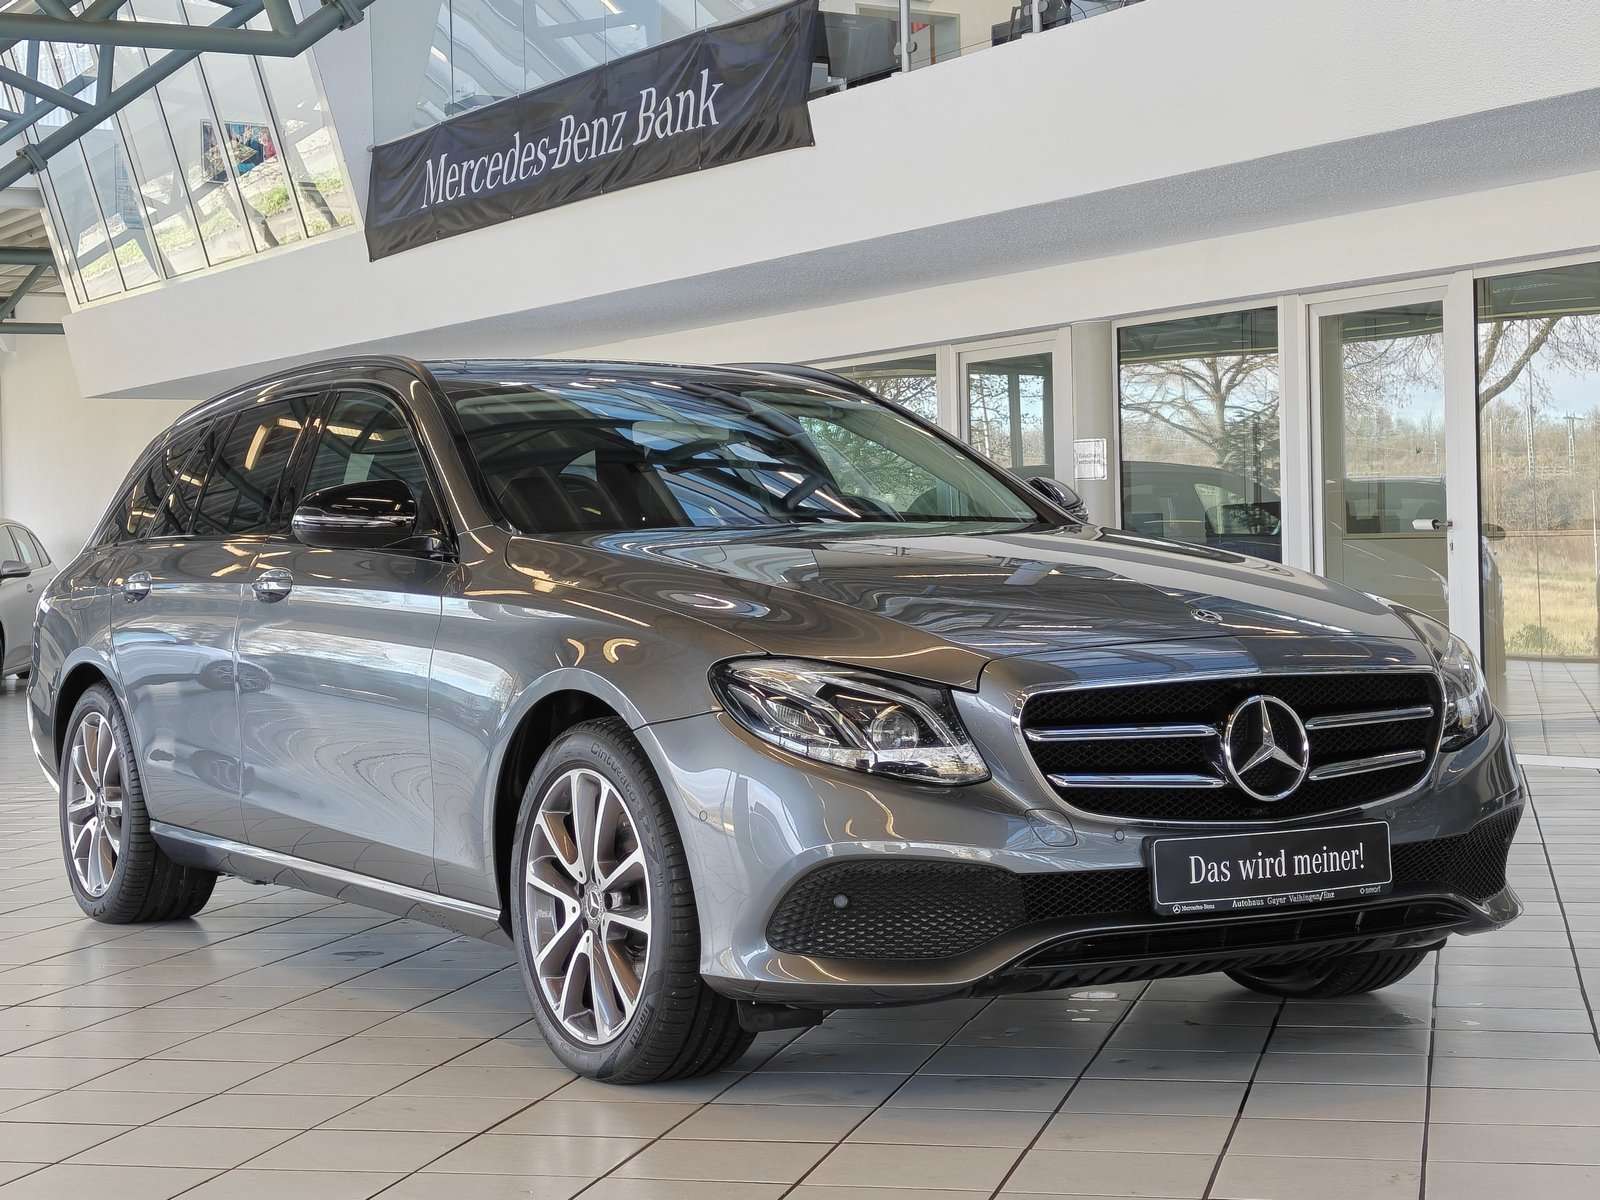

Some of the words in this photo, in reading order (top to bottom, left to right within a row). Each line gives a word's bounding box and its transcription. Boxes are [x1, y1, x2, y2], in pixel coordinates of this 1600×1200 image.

[421, 110, 628, 209] Mercedes-Benz
[634, 69, 724, 145] Bank
[1189, 856, 1231, 884] Das
[1238, 850, 1287, 880] wird
[1293, 842, 1365, 877] meiner!
[1365, 886, 1381, 894] smart
[1182, 903, 1215, 912] Mercedes-Benz
[1232, 898, 1264, 908] Autohaus
